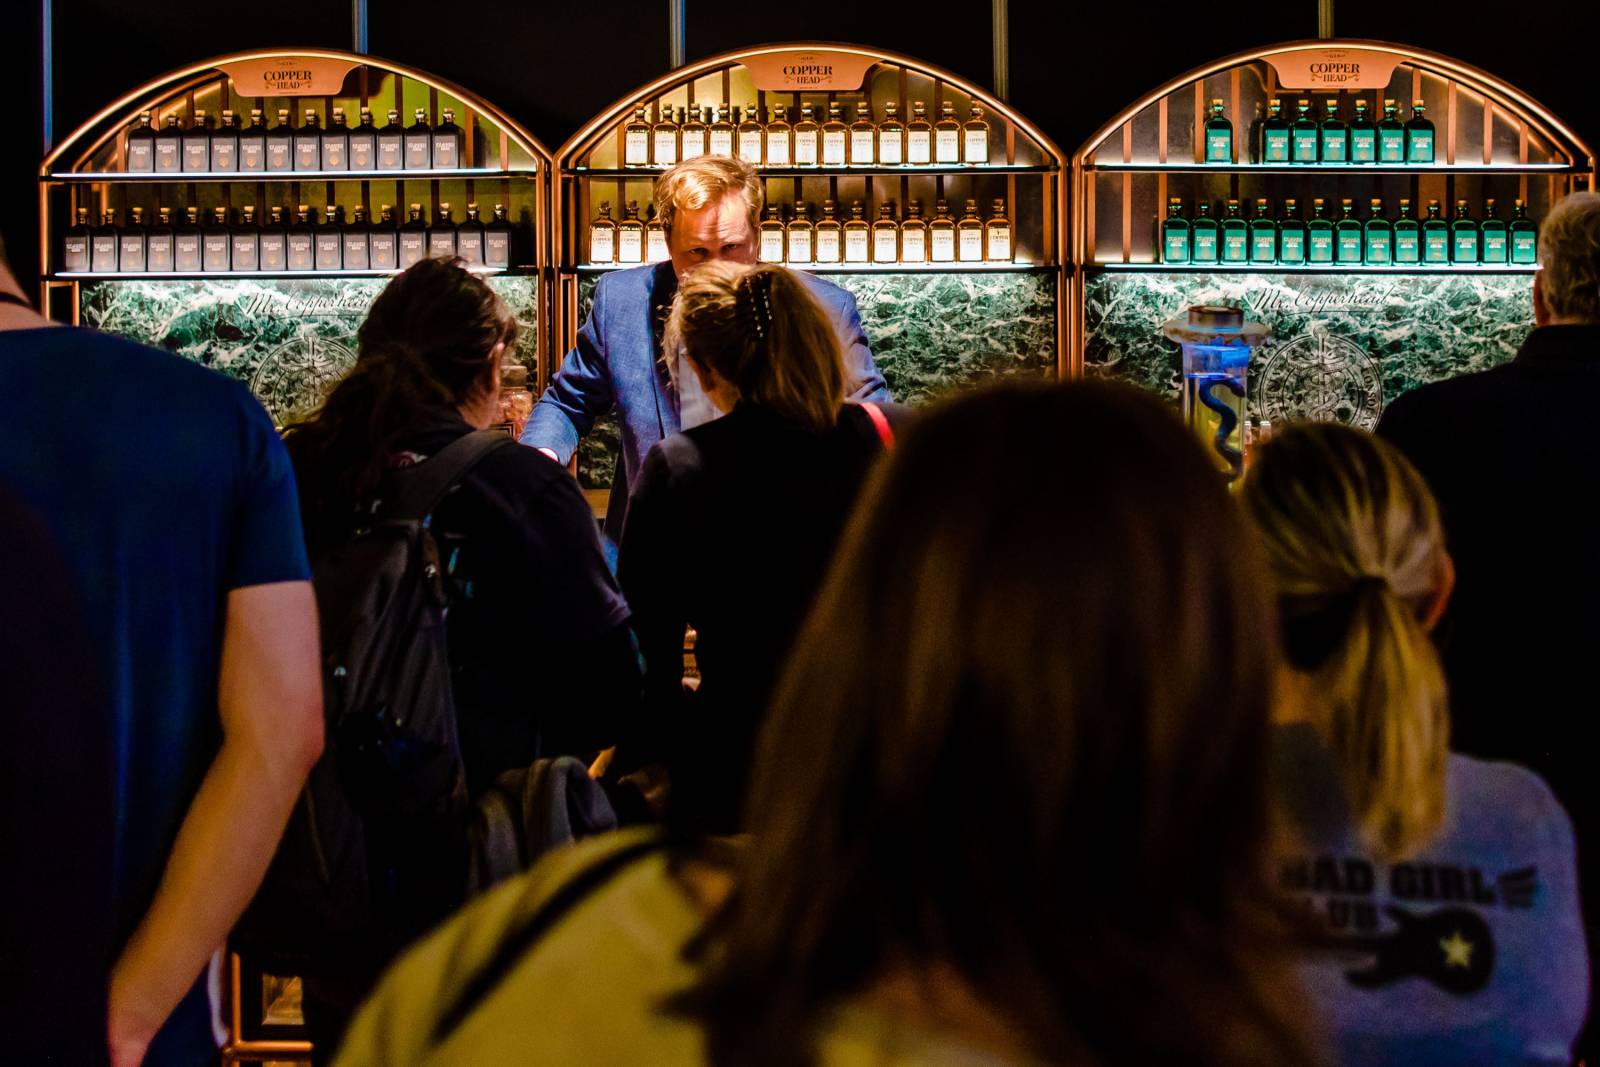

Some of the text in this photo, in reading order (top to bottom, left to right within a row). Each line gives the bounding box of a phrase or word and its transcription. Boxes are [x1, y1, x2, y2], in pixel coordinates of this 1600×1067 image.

[782, 65, 833, 75] COPPER
[1309, 63, 1361, 74] COPPER
[263, 70, 313, 81] COPPER
[796, 76, 821, 84] HEAD
[1323, 74, 1348, 82] HEAD
[276, 81, 301, 89] HEAD
[1294, 284, 1396, 314] Copperhead
[1391, 862, 1496, 904] GIRL
